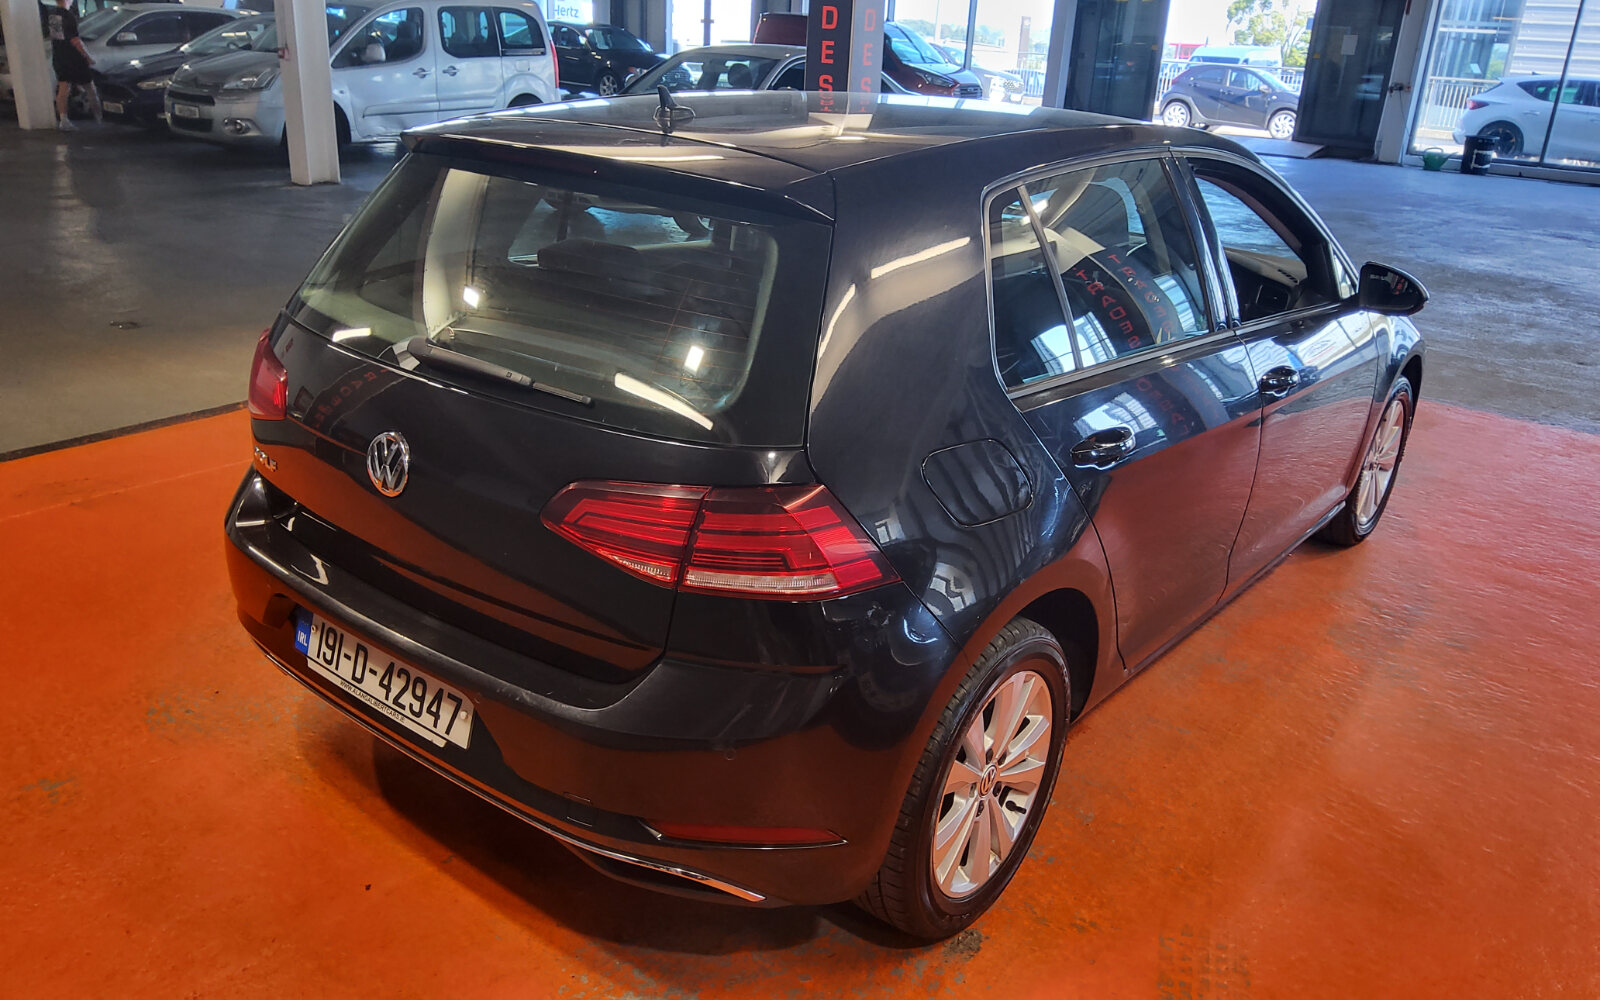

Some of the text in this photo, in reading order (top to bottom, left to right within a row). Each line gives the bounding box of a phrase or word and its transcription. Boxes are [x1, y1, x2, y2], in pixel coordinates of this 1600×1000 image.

[553, 5, 579, 18] Hertz
[297, 629, 308, 647] IRL
[316, 622, 463, 736] 191-D-42947
